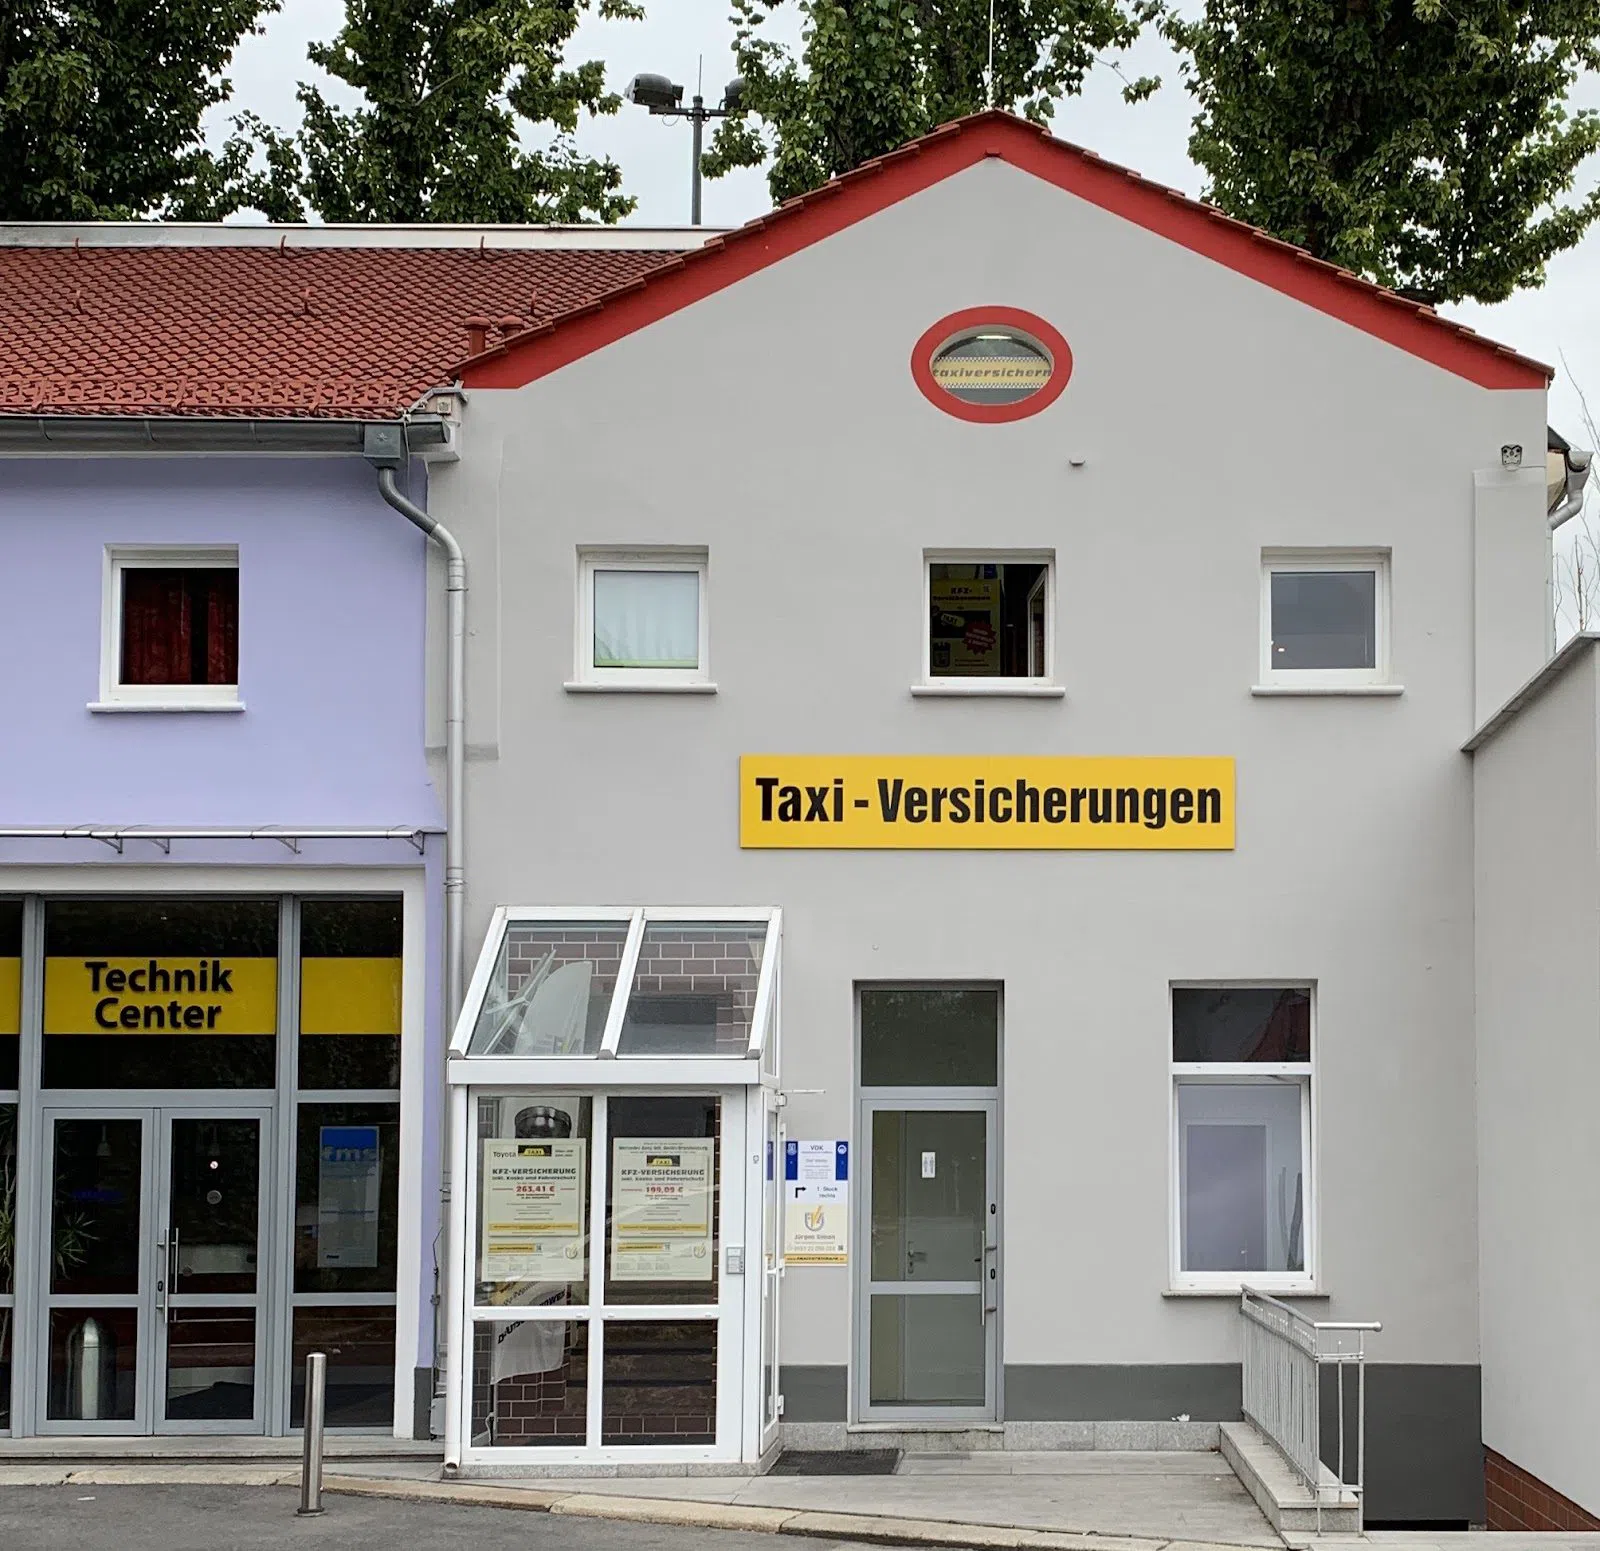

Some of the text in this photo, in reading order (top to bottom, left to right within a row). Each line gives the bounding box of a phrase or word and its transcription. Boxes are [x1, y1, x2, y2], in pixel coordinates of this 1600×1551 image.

[755, 777, 844, 822] Taxi
[877, 778, 1222, 830] Versicherungen
[84, 960, 234, 993] Technik
[95, 997, 222, 1029] Center
[492, 1151, 517, 1159] Toyota
